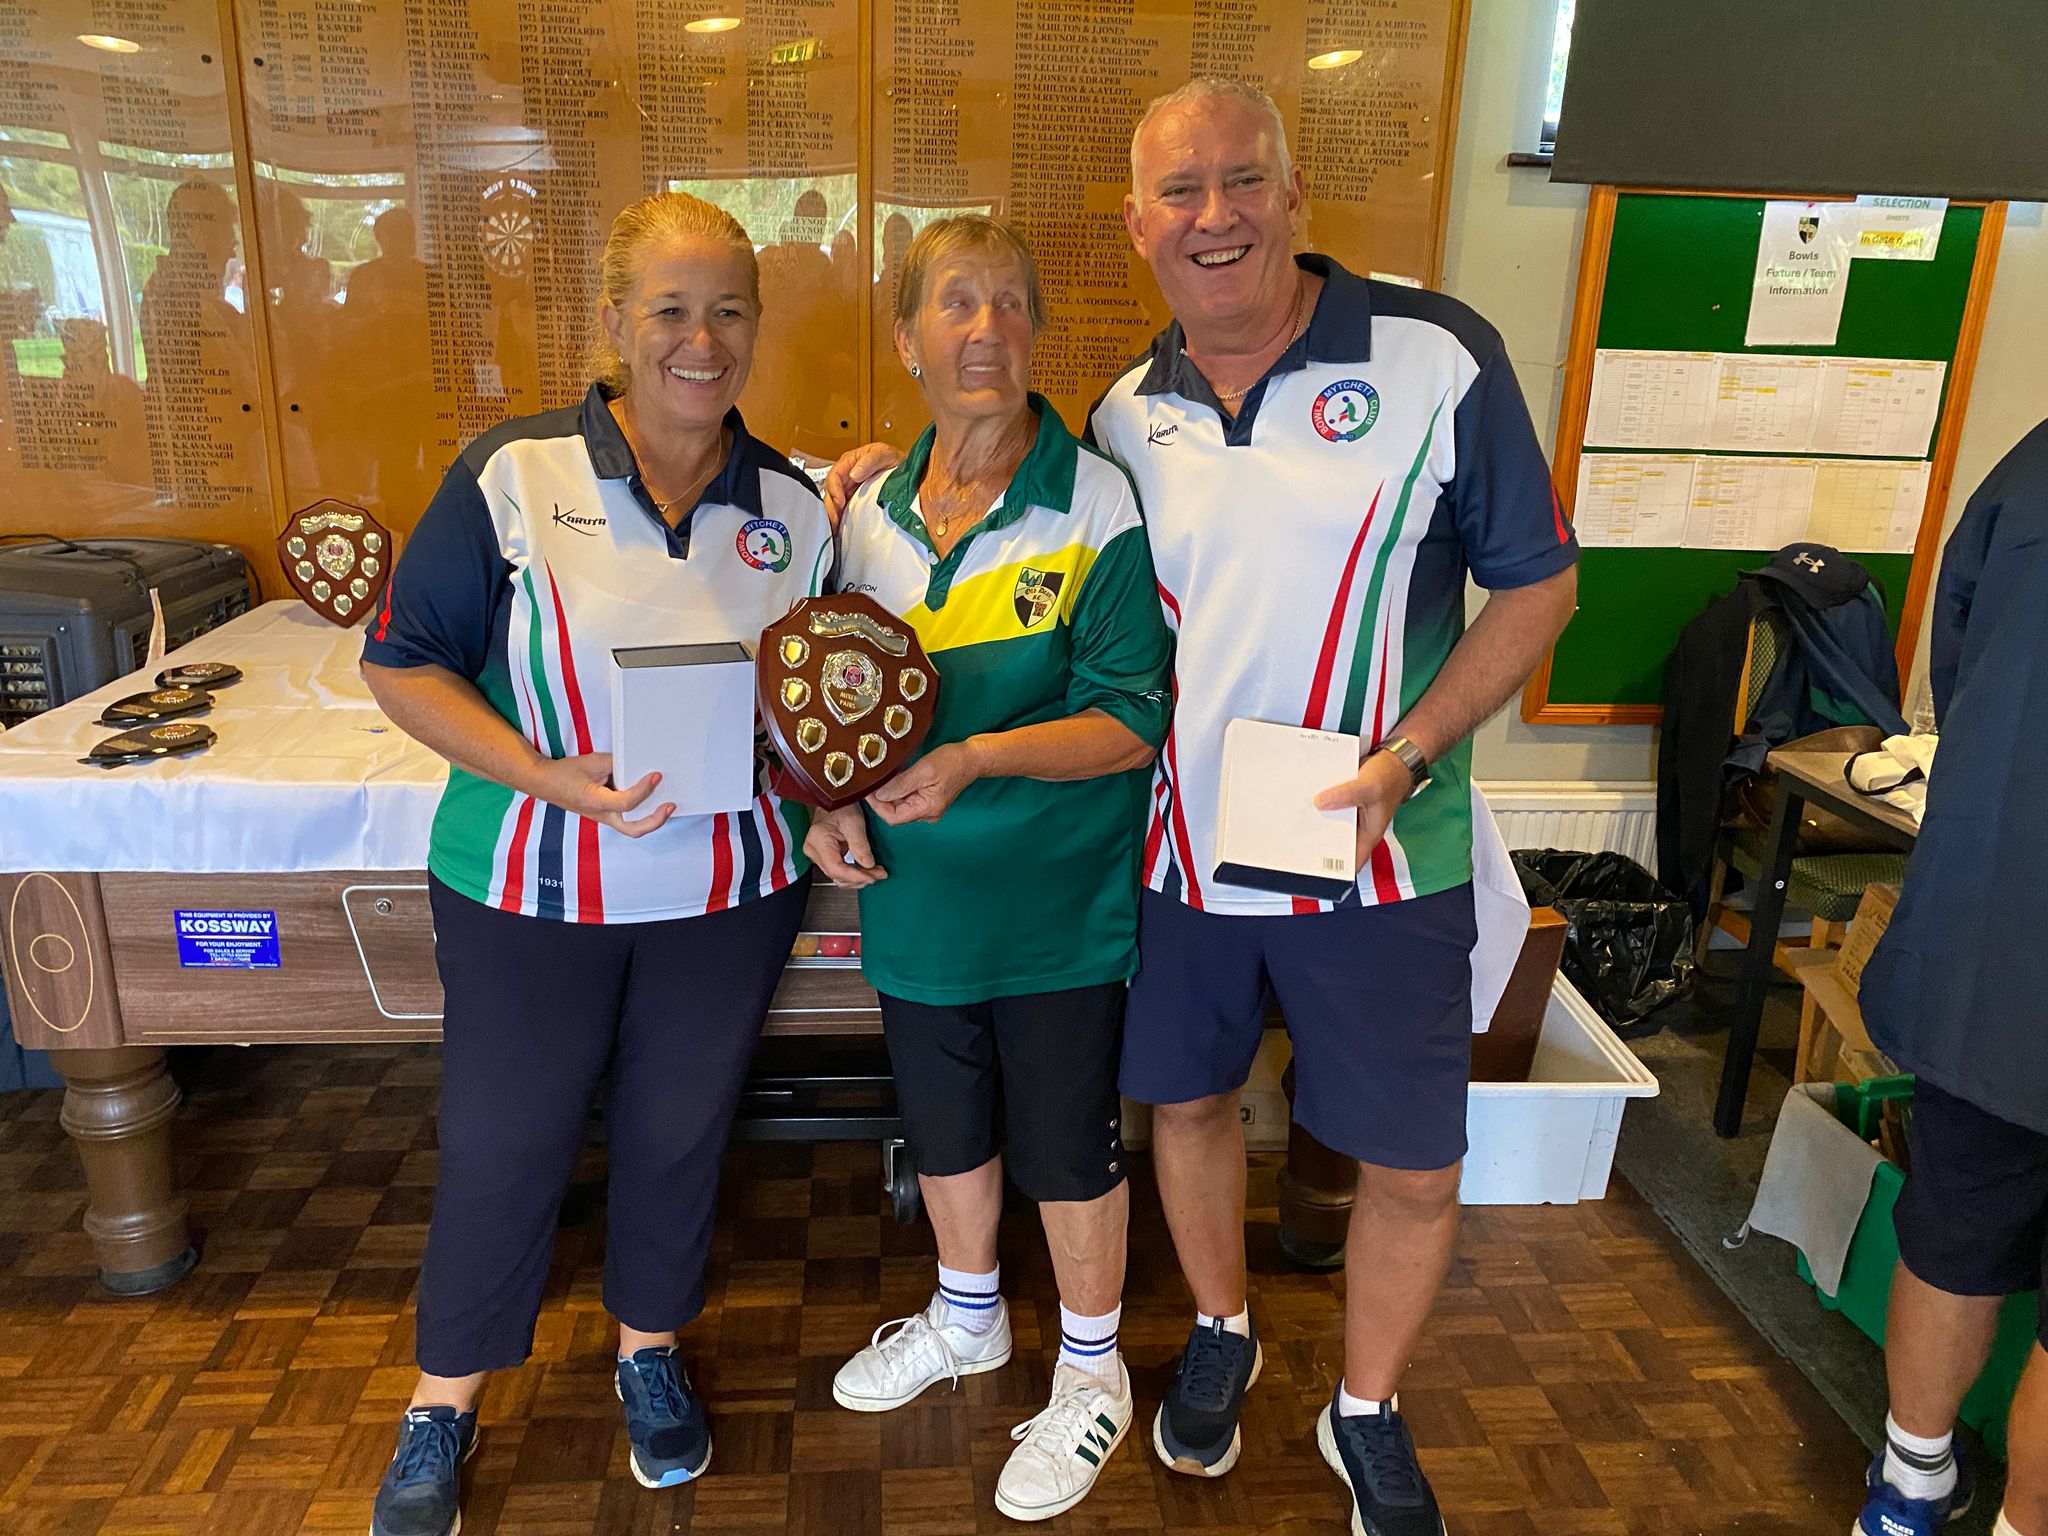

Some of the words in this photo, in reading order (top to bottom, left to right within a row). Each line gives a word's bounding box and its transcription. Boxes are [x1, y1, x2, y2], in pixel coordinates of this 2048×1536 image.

[518, 3, 535, 11] 1971
[1212, 42, 1254, 51] M.HILTON
[915, 67, 961, 77] M.BROOKS
[915, 77, 959, 87] M.HILTON
[1318, 118, 1352, 126] C.SHARP
[1317, 128, 1353, 136] C.SHARP
[914, 137, 957, 146] M.HILTON
[913, 167, 931, 175] NOT
[934, 168, 968, 176] PLAYED
[1030, 173, 1073, 181] M.HILTON
[1873, 198, 1931, 209] SELECTION
[551, 208, 599, 217] S.HARMAN
[1788, 250, 1819, 260] Bowls
[1766, 268, 1801, 278] Fixture
[1810, 268, 1836, 278] Team
[1769, 285, 1828, 296] Information
[450, 301, 491, 310] K.CROOK
[453, 340, 494, 348] K.CROOK
[1323, 381, 1375, 399] MYTCHETT
[456, 395, 512, 404] L.MULCAHY
[1313, 400, 1329, 434] BOWLS
[1366, 400, 1378, 425] CLUB
[744, 520, 787, 534] MYTCHETT
[737, 533, 755, 563] BOWLS
[783, 540, 792, 563] CLUB
[539, 877, 563, 889] 1931
[180, 919, 273, 933] KOSSWAY
[1881, 1514, 1915, 1536] DRAKES
